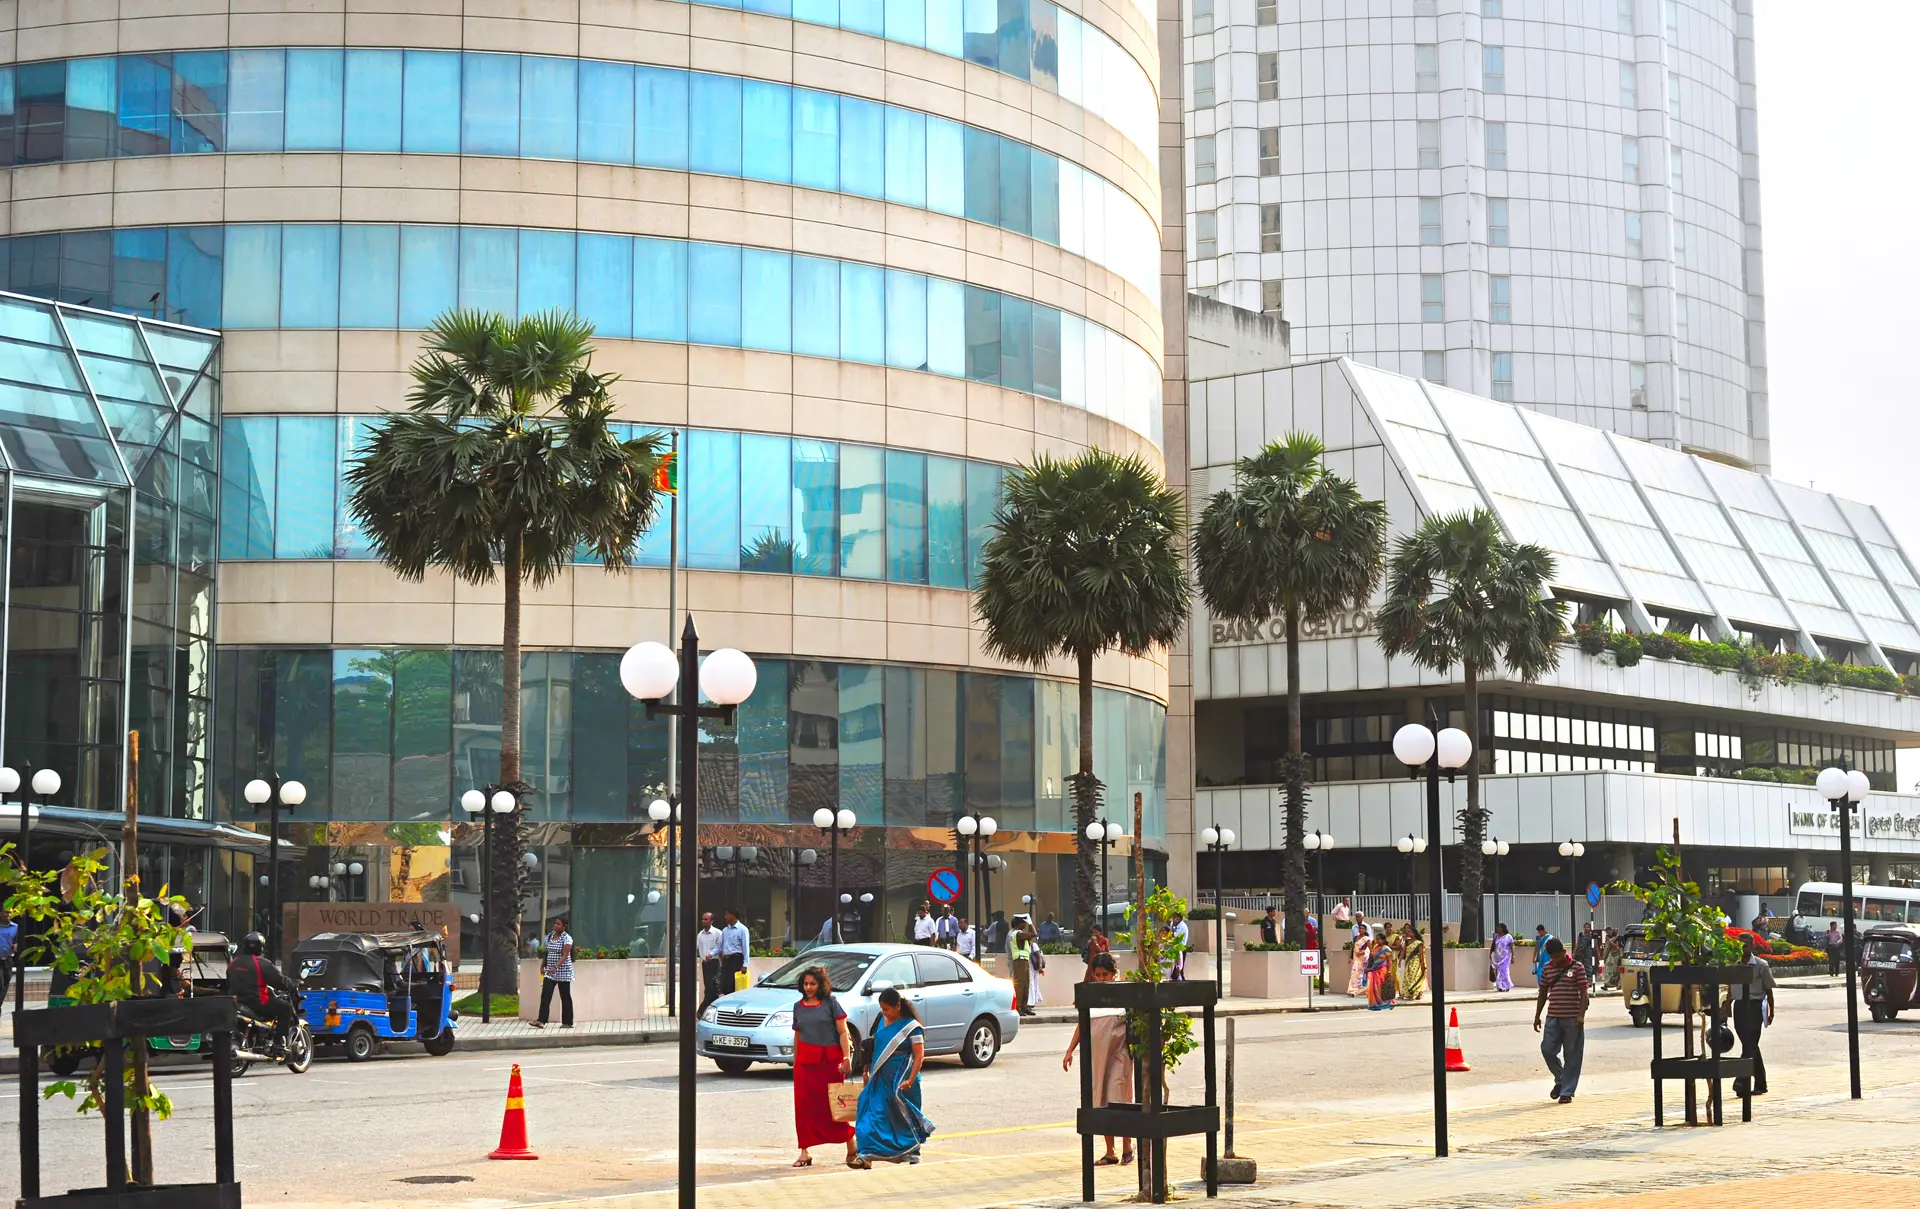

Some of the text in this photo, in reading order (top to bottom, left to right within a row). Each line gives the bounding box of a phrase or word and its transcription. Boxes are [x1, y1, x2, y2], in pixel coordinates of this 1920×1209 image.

[1212, 620, 1264, 643] BANK
[1269, 618, 1287, 639] O
[1793, 811, 1814, 828] BANK
[1817, 813, 1828, 828] OF
[320, 909, 443, 926] WORLD TRADE
[719, 1036, 727, 1045] KE
[733, 1037, 747, 1046] 3572
